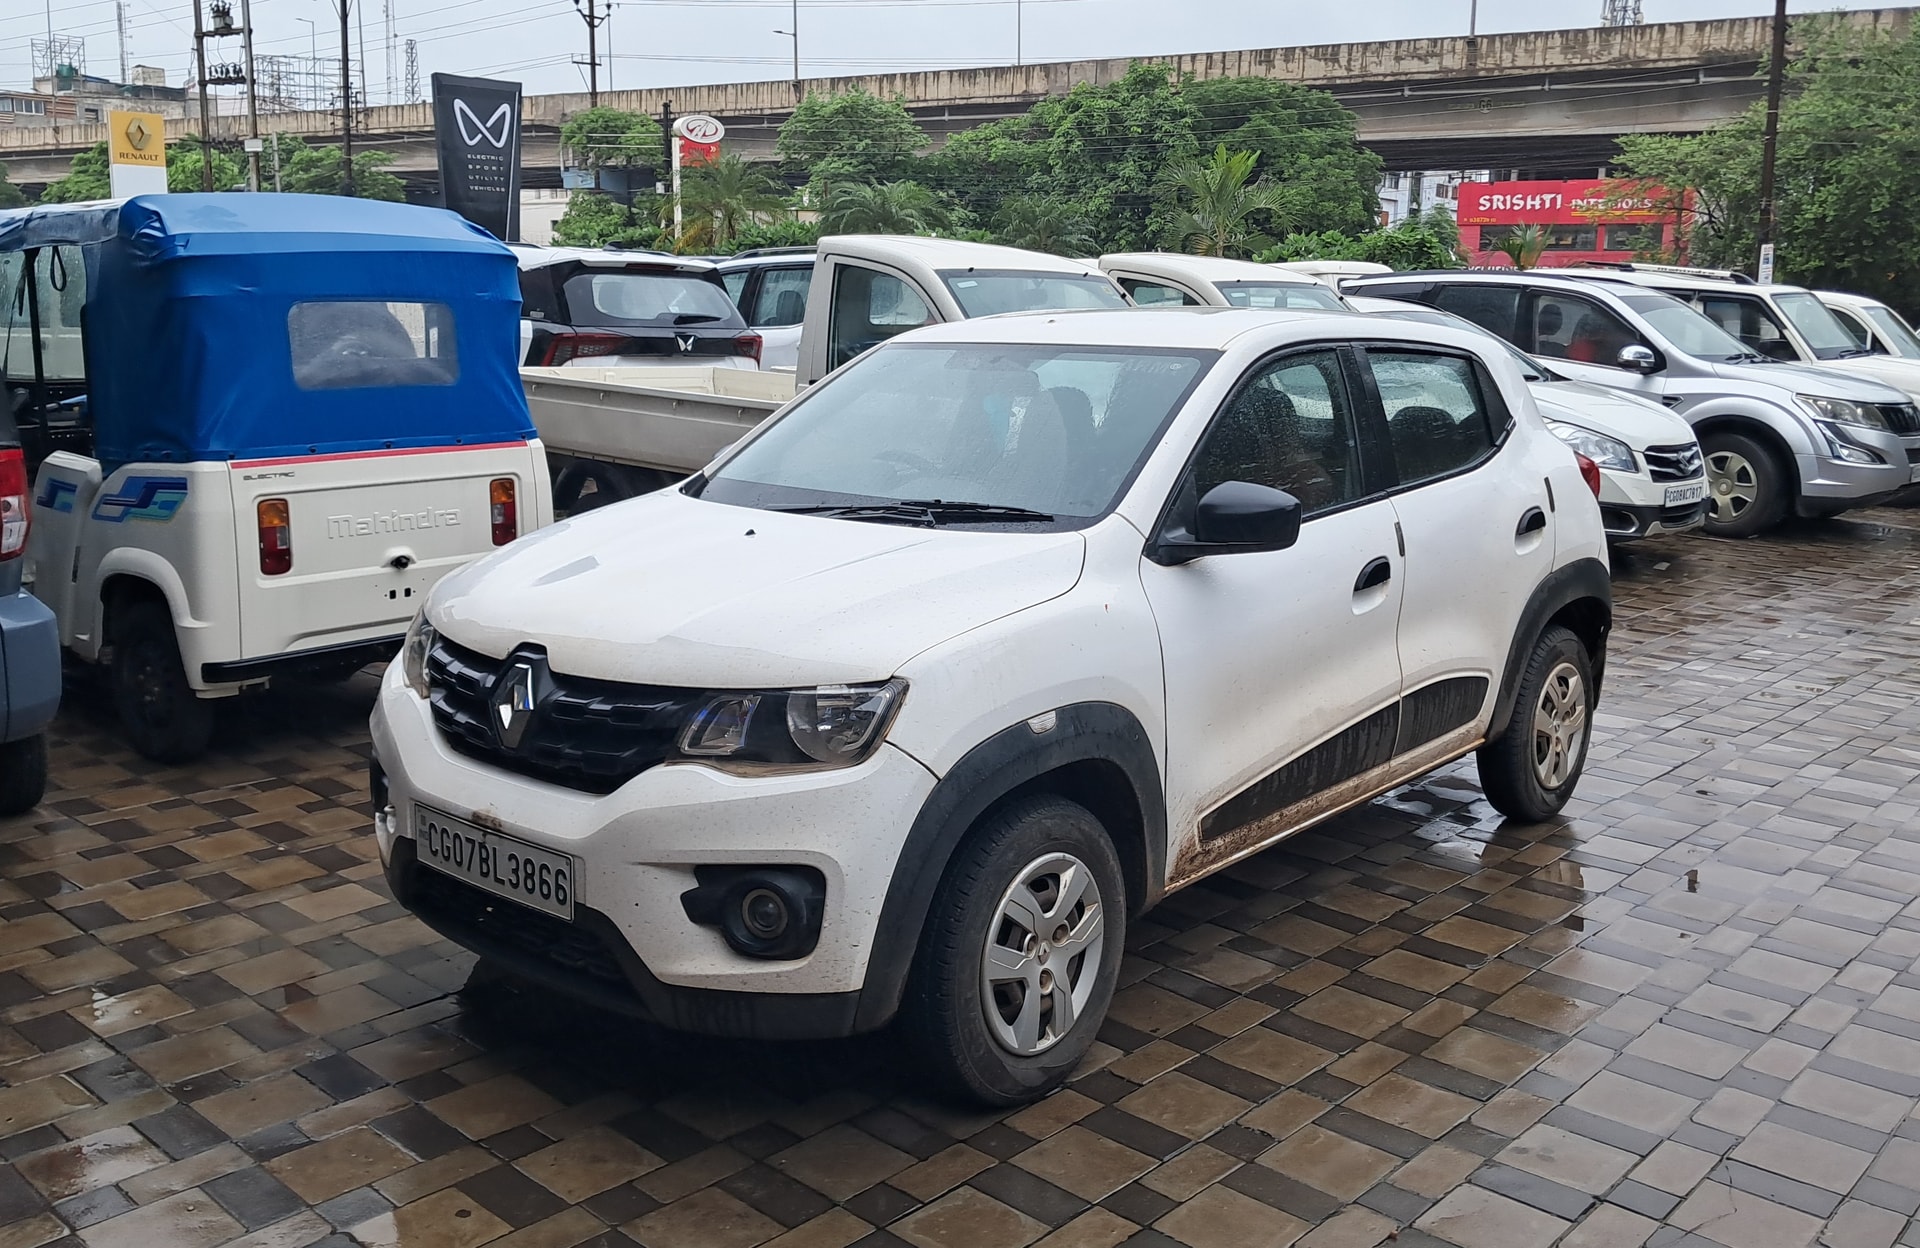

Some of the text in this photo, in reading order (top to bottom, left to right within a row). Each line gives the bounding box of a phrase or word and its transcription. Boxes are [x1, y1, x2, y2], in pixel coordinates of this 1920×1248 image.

[119, 152, 159, 161] RENAULT
[1478, 193, 1652, 211] SRISHTI INTEIORS
[243, 471, 295, 481] ELECTRIC
[327, 506, 461, 539] Mahindra
[428, 822, 568, 906] CG07BL3866
